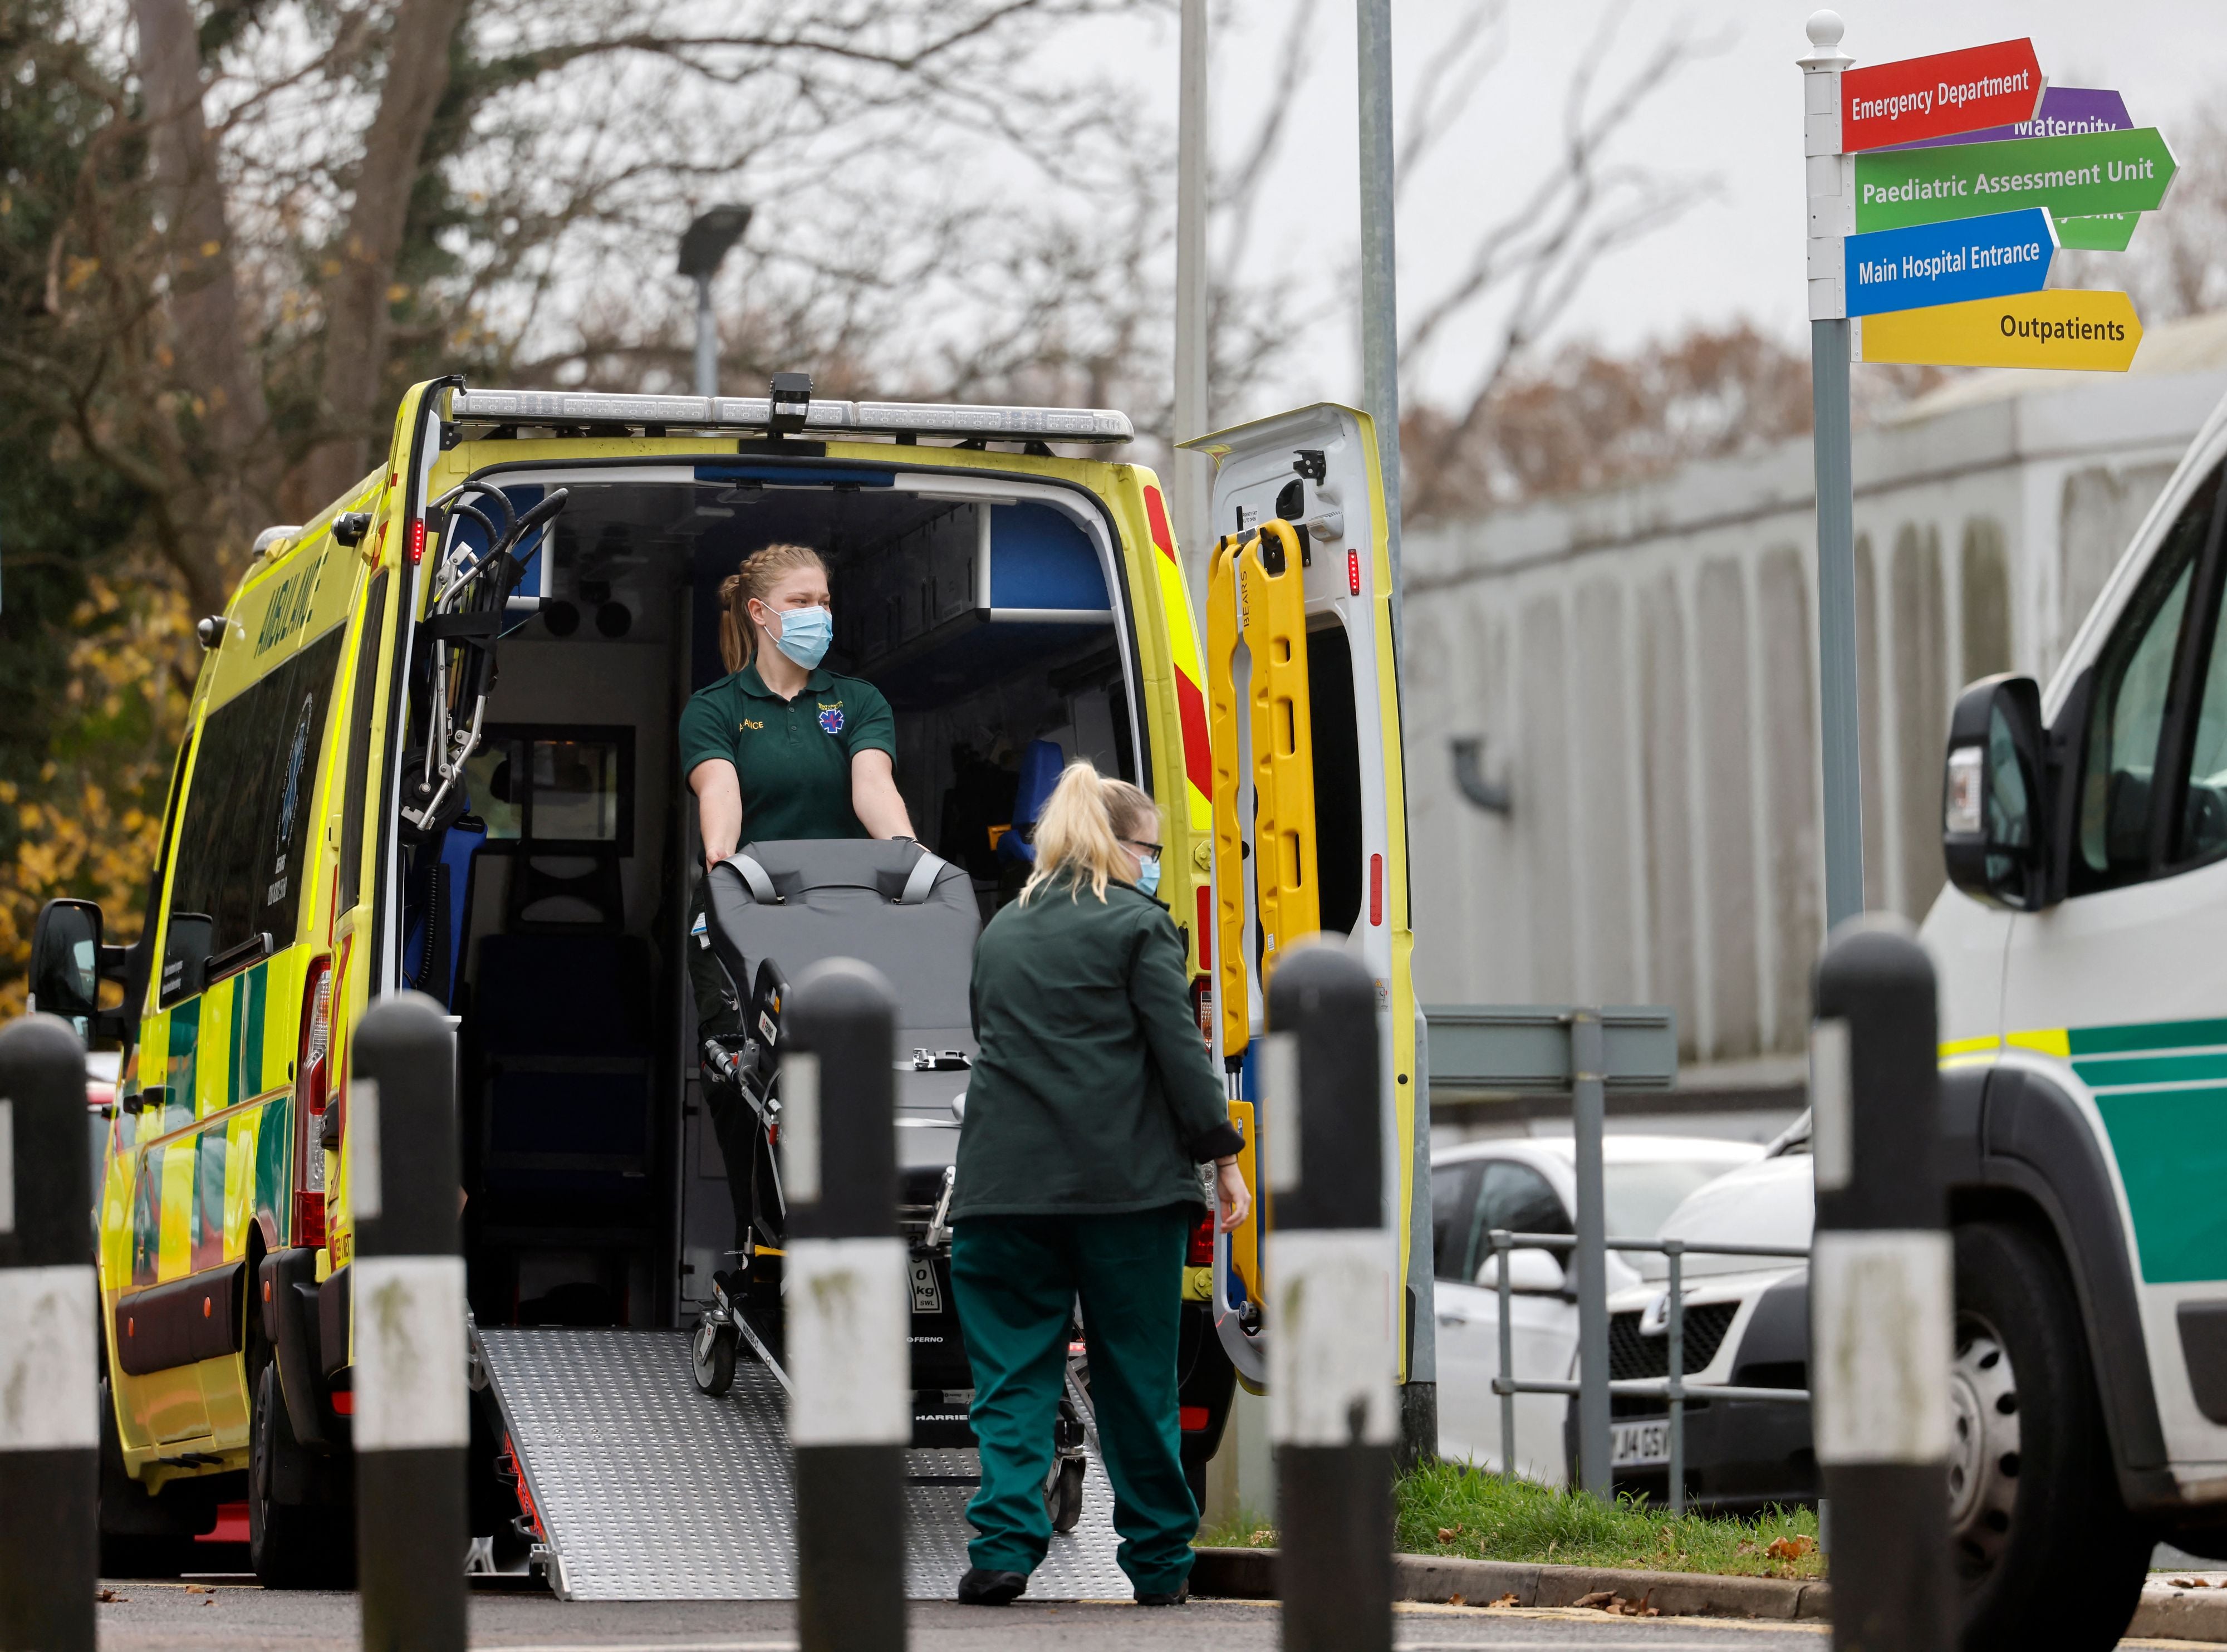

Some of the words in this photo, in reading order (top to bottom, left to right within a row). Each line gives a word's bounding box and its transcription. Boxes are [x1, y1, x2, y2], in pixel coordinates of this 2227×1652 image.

[1852, 90, 1933, 121] Emergency
[1938, 68, 2029, 108] Department
[1863, 175, 1967, 204] Paediatric
[1974, 164, 2101, 195] Assessment
[2108, 158, 2154, 182] Unit
[1859, 258, 1897, 285] Main
[1902, 247, 1966, 281] Hospital
[1971, 242, 2040, 269] Entrance
[2000, 315, 2125, 344] Outpatients
[1240, 571, 1250, 628] BEARS
[916, 1286, 934, 1297] kg
